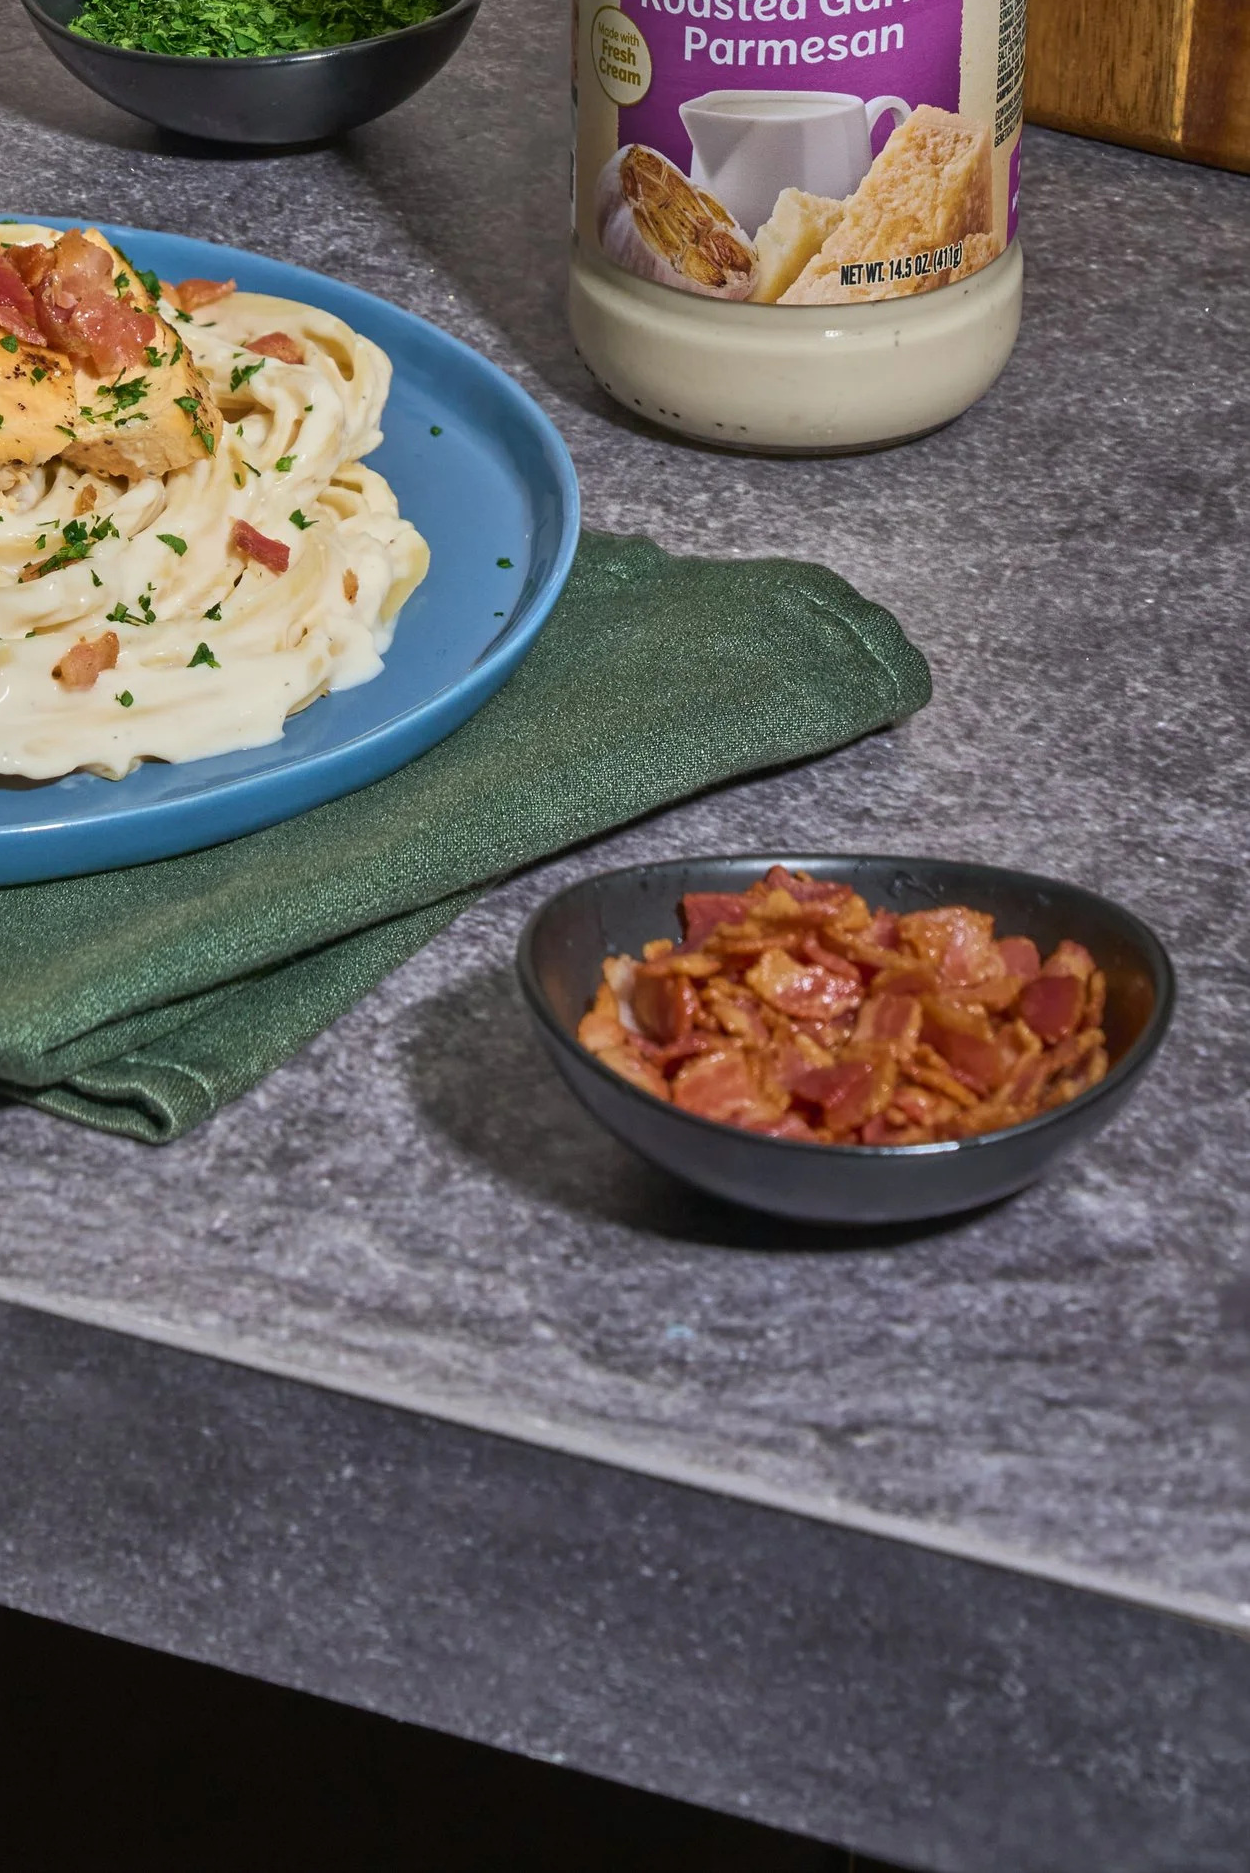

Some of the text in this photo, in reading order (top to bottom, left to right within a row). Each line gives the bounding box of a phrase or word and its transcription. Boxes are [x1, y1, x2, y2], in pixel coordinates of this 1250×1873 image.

[598, 22, 640, 47] Made with
[684, 22, 904, 66] Parmesan
[602, 38, 636, 66] Fresh
[599, 56, 641, 86] Cream
[840, 241, 963, 286] NET WT. 14.5 OZ. (411g)
